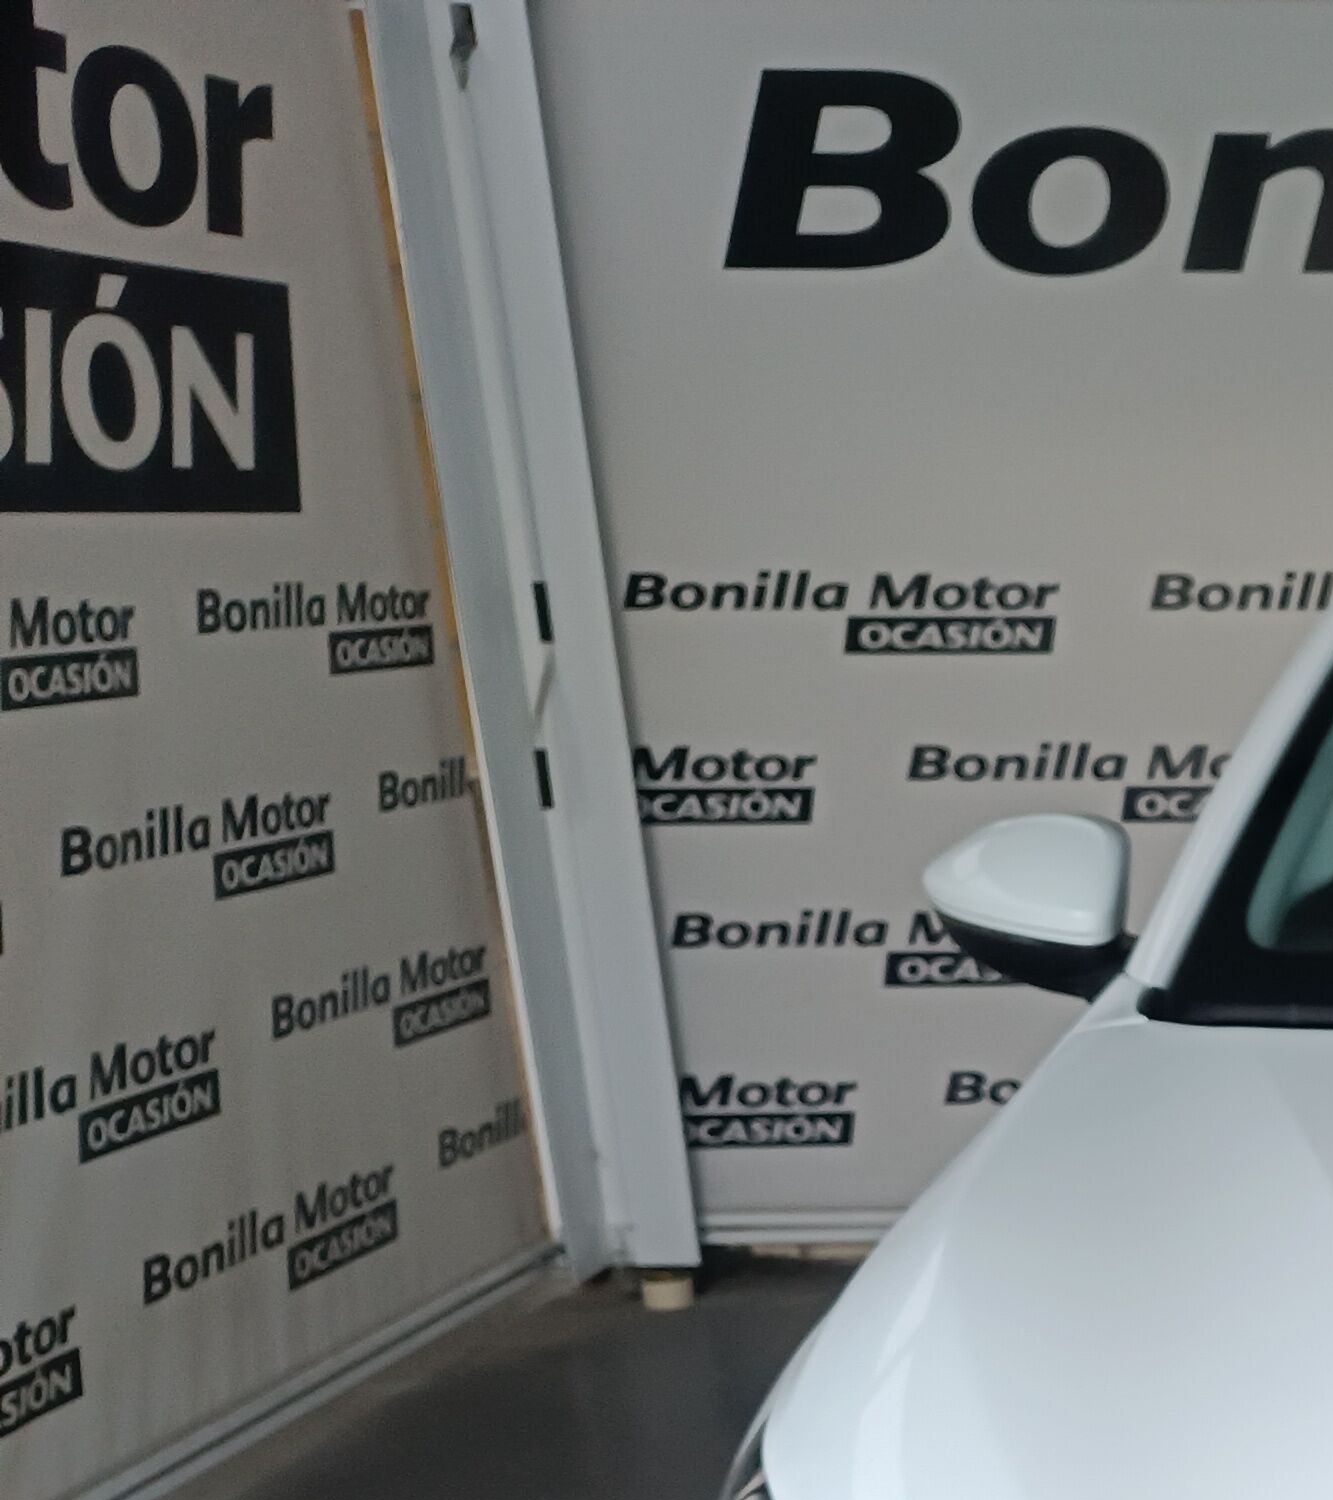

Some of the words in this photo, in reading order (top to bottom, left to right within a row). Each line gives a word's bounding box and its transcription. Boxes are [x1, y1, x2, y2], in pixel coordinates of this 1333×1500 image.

[0, 274, 255, 472] IÓN
[197, 582, 326, 635] Bonilla
[337, 582, 430, 625] Motor
[622, 571, 849, 611] Bonilla
[870, 573, 1060, 611] Motor
[9, 597, 135, 650] Motor
[336, 630, 429, 667] OCASIÓN
[858, 617, 1046, 650] OCASIÓN
[8, 652, 132, 701] OCASIÓN
[631, 745, 817, 781] Motor
[908, 742, 1126, 782] Bonilla
[641, 788, 804, 820] CASIÓN
[61, 804, 211, 876] Bonilla
[221, 793, 331, 842] Motor
[222, 834, 329, 890] OCASIÓN
[672, 910, 889, 949] Bonilla
[271, 967, 390, 1039] Bonilla
[401, 945, 487, 995] Motor
[89, 1029, 215, 1101] Motor
[680, 1073, 856, 1108] Motor
[88, 1080, 213, 1151] OCASIÓN
[439, 1099, 527, 1167] Bonill
[687, 1112, 843, 1144] CASIÓN
[144, 1208, 284, 1305] Bonilla
[294, 1164, 394, 1232] Motor
[295, 1210, 393, 1280] OCASIÓN
